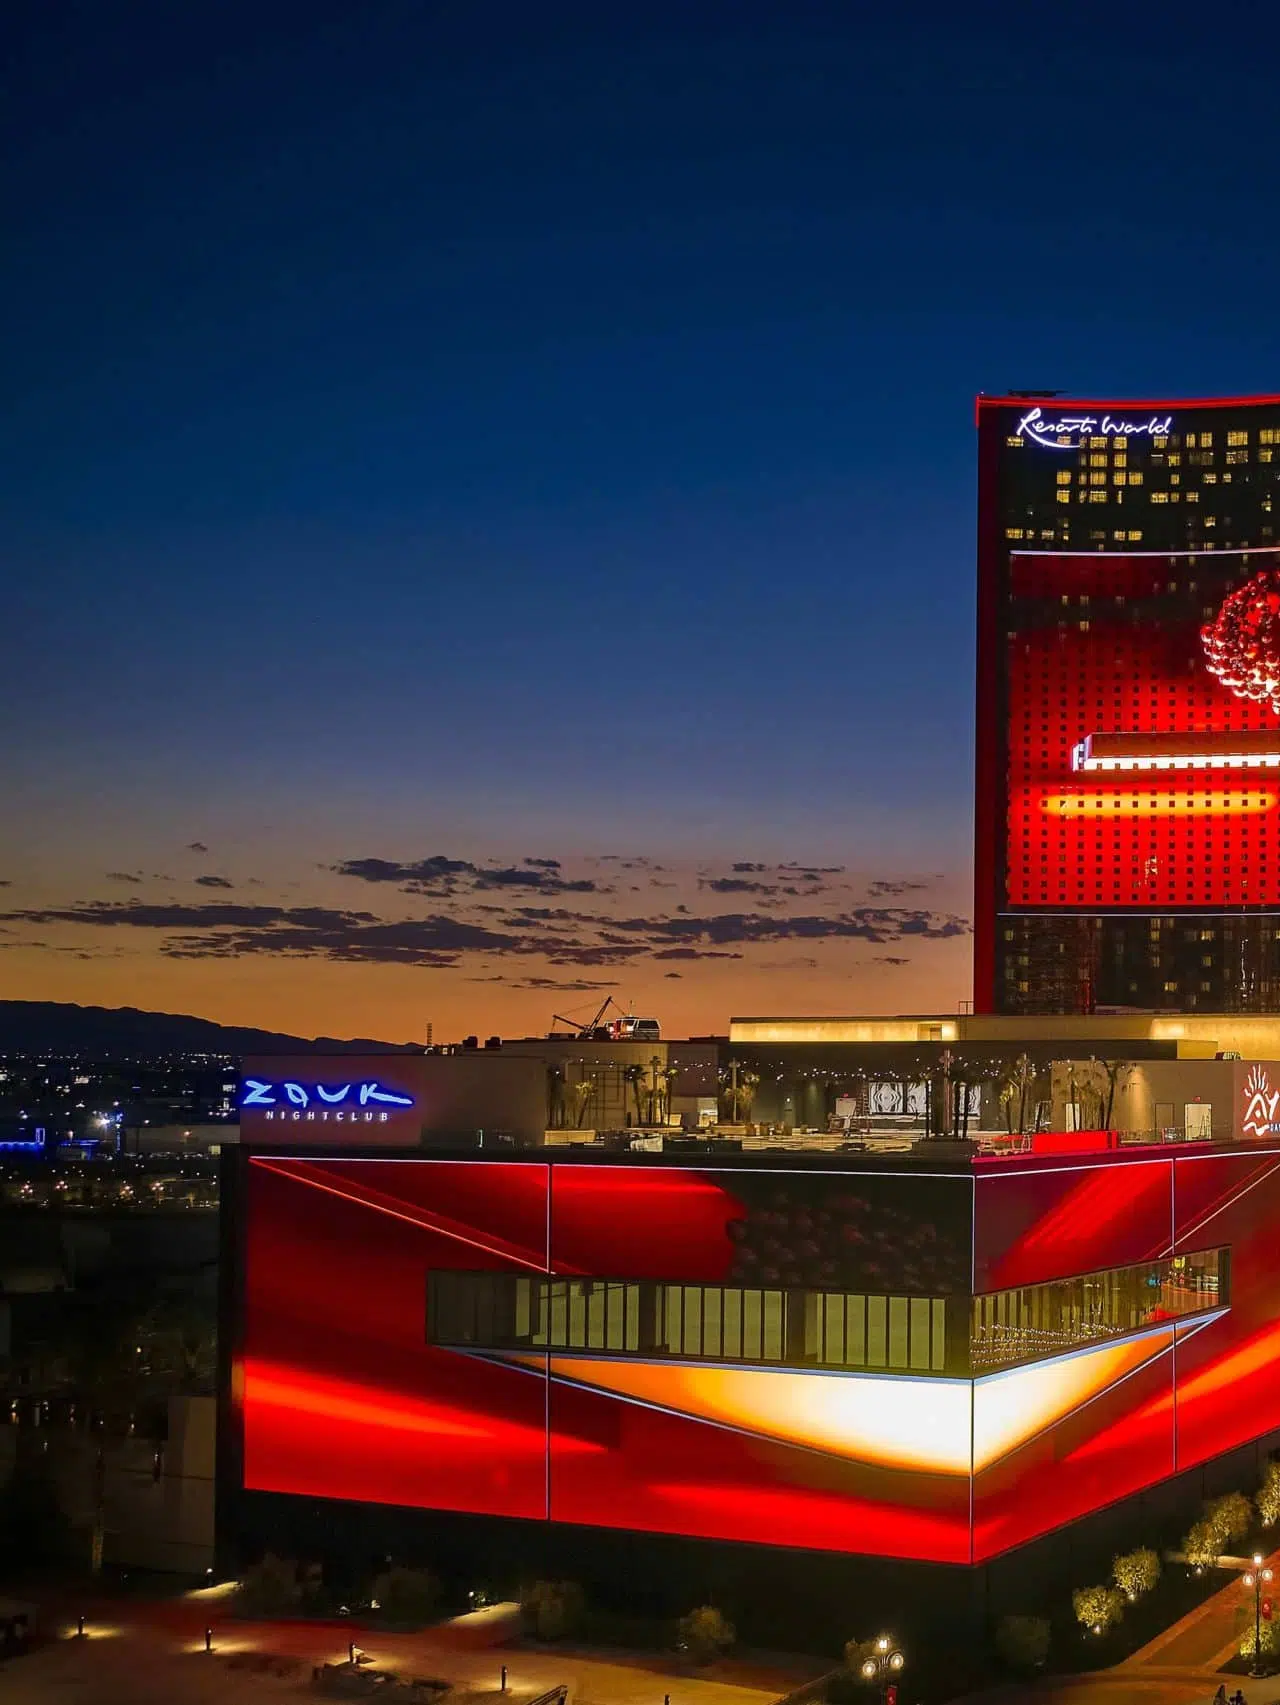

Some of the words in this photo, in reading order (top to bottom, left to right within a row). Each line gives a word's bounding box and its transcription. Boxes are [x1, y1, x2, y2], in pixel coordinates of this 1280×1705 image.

[1016, 407, 1097, 448] Resorts
[1101, 415, 1172, 434] World
[243, 1080, 413, 1109] ZOUK
[265, 1111, 388, 1122] NIGHTCLUB
